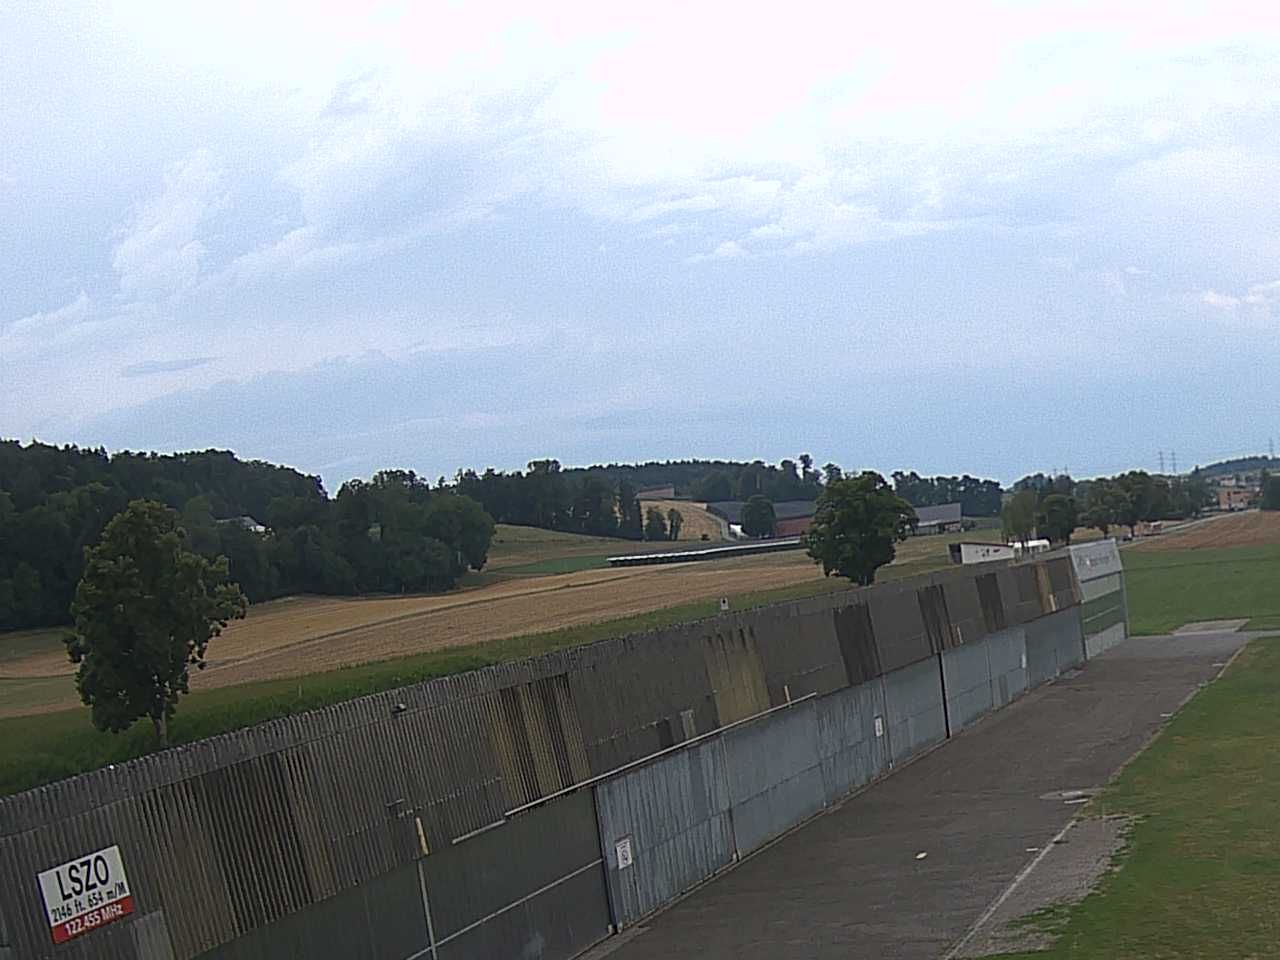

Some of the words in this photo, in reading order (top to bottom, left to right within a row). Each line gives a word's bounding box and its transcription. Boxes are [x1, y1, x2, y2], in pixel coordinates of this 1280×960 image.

[56, 854, 109, 901] LSZO
[51, 904, 72, 922] 2146
[87, 891, 103, 907] 654
[100, 904, 123, 921] MHz
